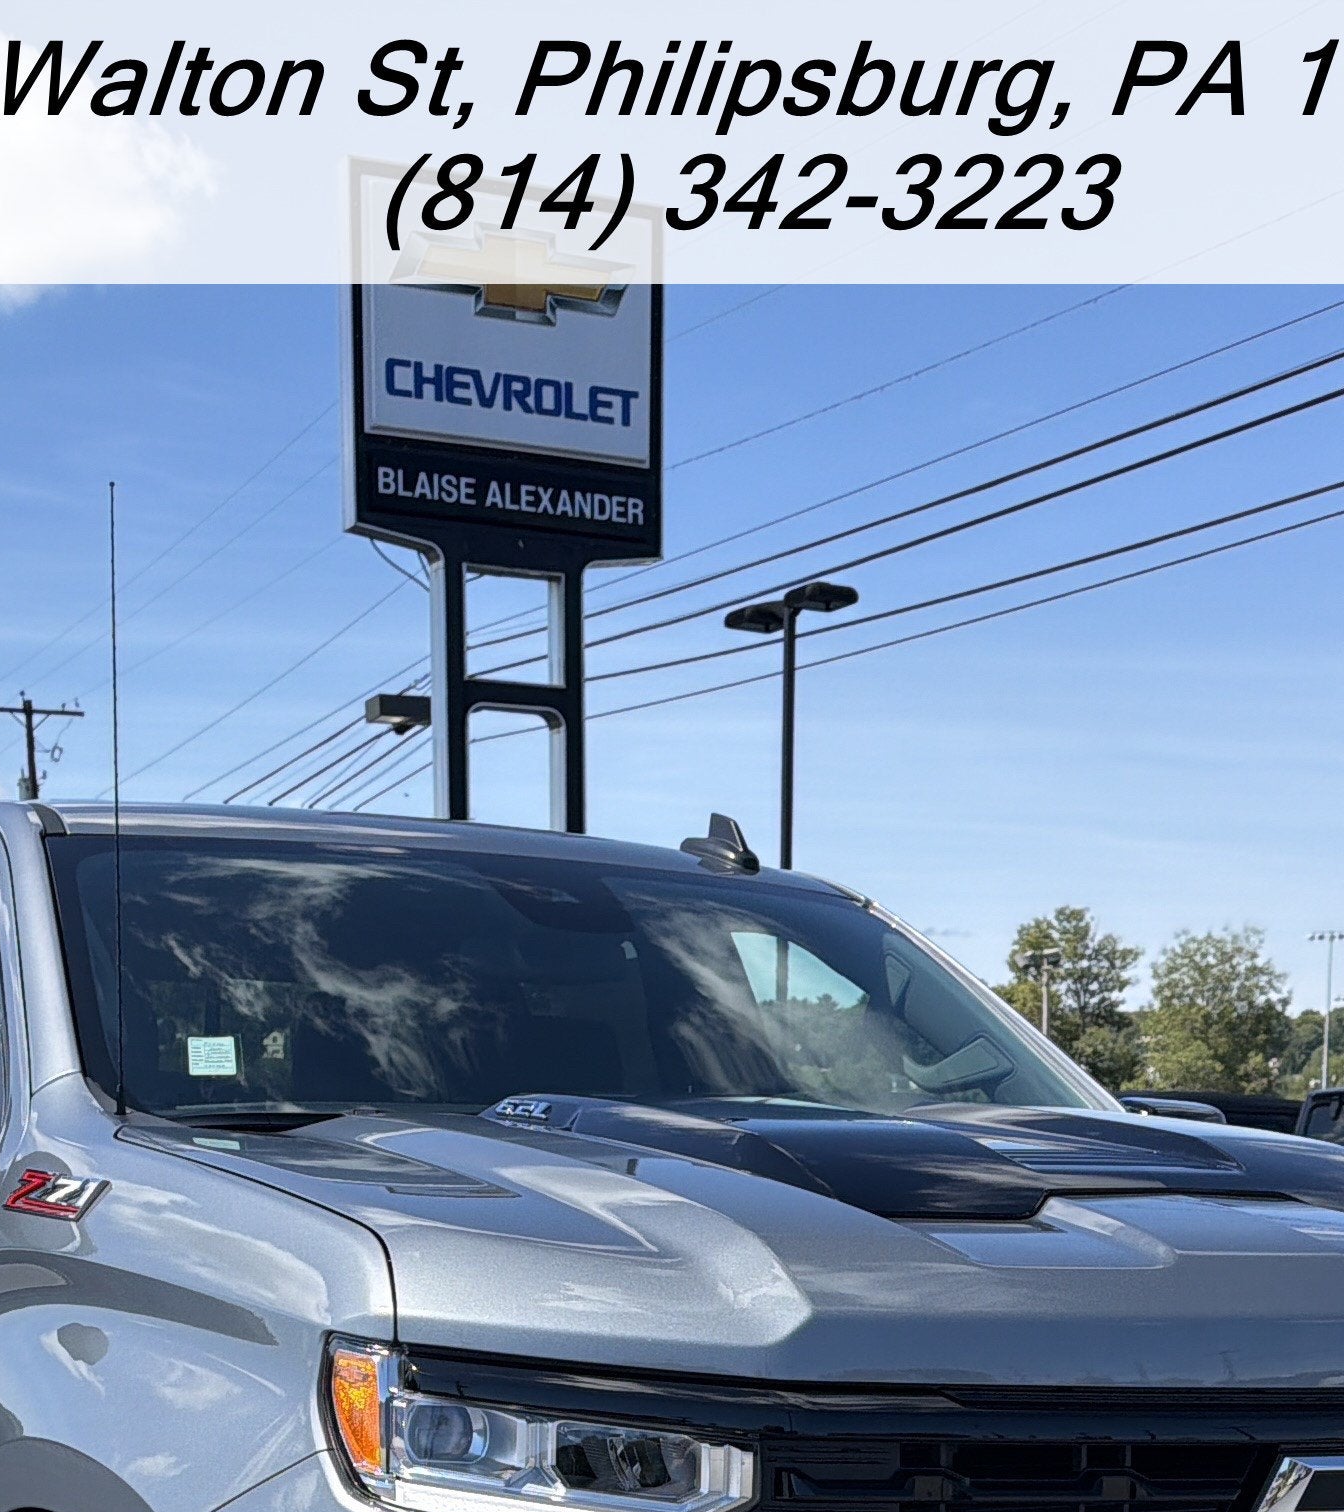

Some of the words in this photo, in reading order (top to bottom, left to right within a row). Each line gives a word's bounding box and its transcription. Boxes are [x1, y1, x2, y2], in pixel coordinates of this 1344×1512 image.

[385, 357, 640, 427] CHEVROLET
[377, 466, 477, 506] BLAISE
[485, 480, 645, 525] ALEXANDER
[2, 1168, 113, 1222] Z71
